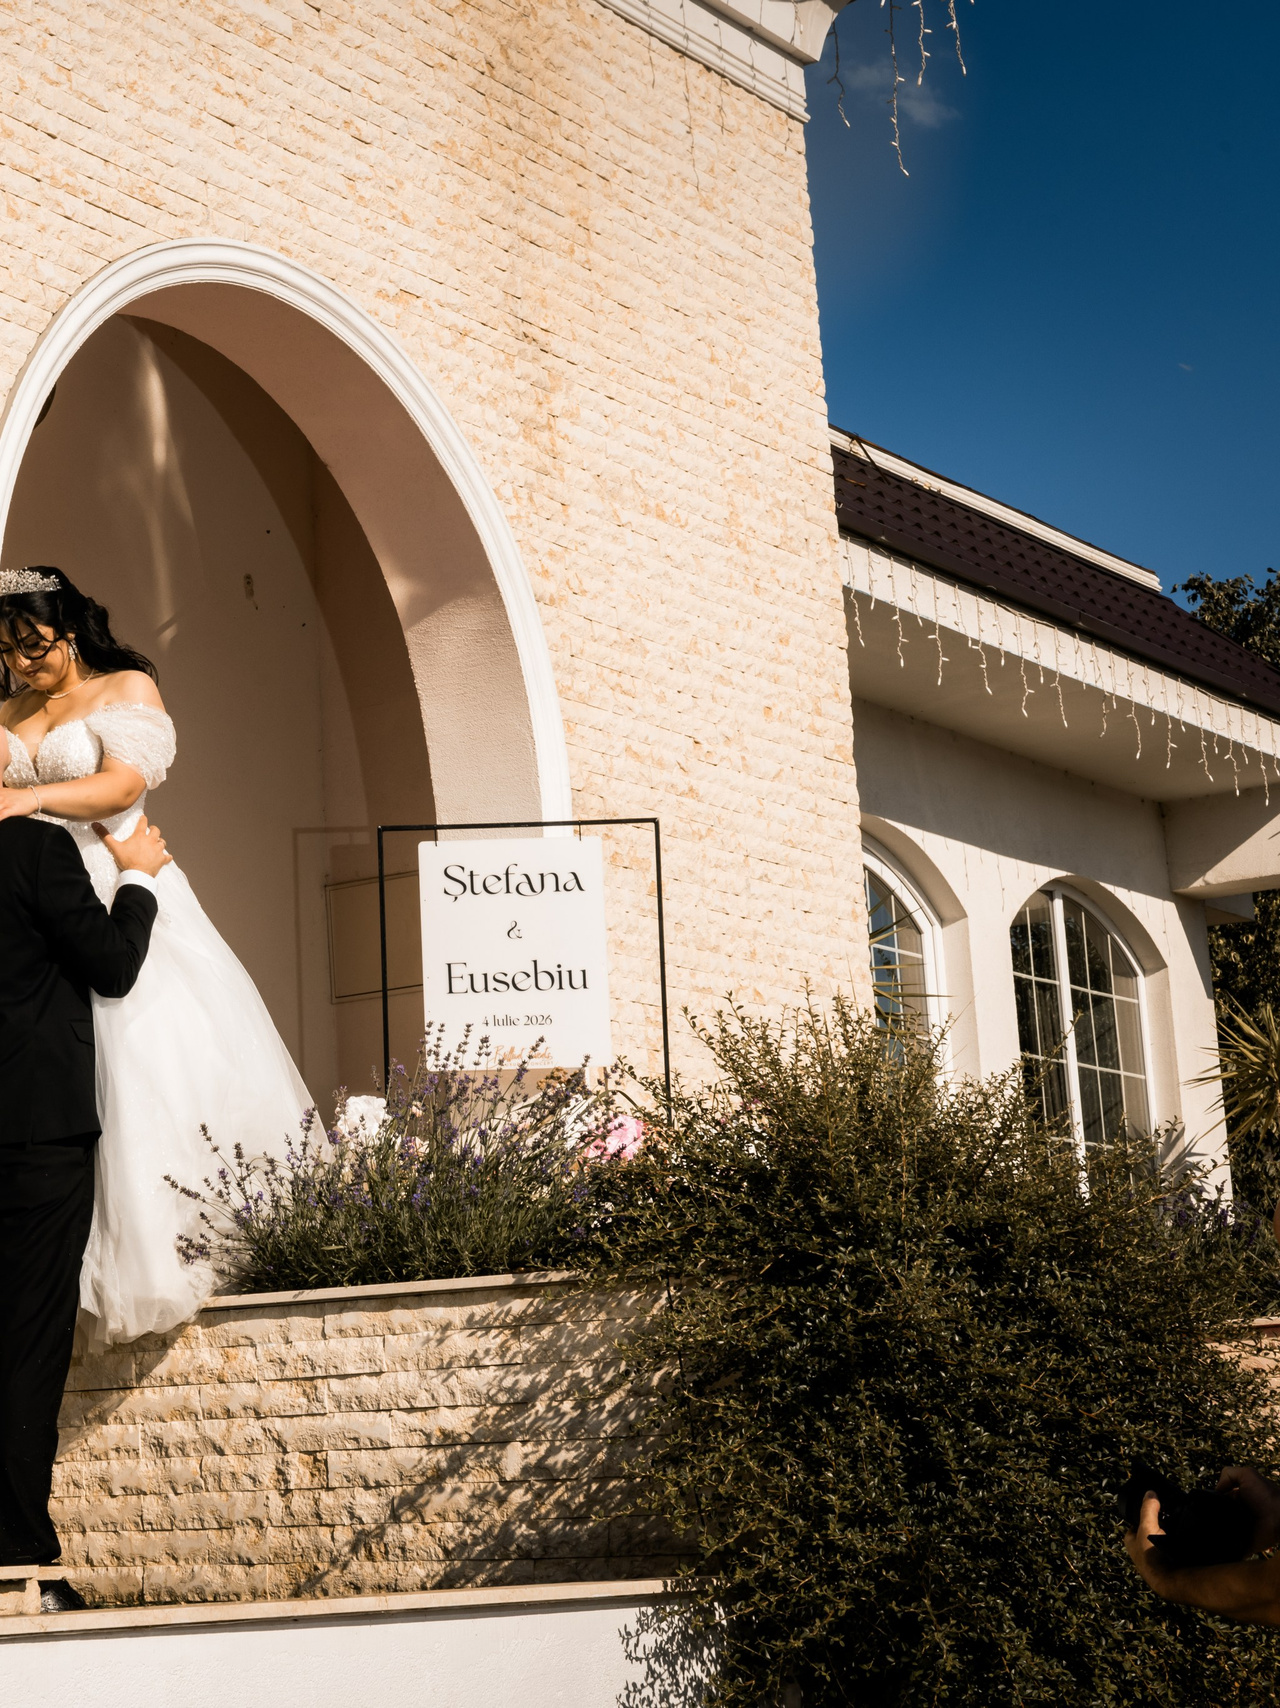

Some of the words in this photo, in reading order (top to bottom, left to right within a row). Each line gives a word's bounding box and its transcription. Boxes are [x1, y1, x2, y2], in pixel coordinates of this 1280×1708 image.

[443, 863, 586, 902] Ștefana
[506, 920, 523, 940] &
[445, 959, 589, 994] Eusebiu
[482, 1016, 490, 1027] 4
[493, 1014, 520, 1027] Iulie
[523, 1014, 553, 1026] 2026
